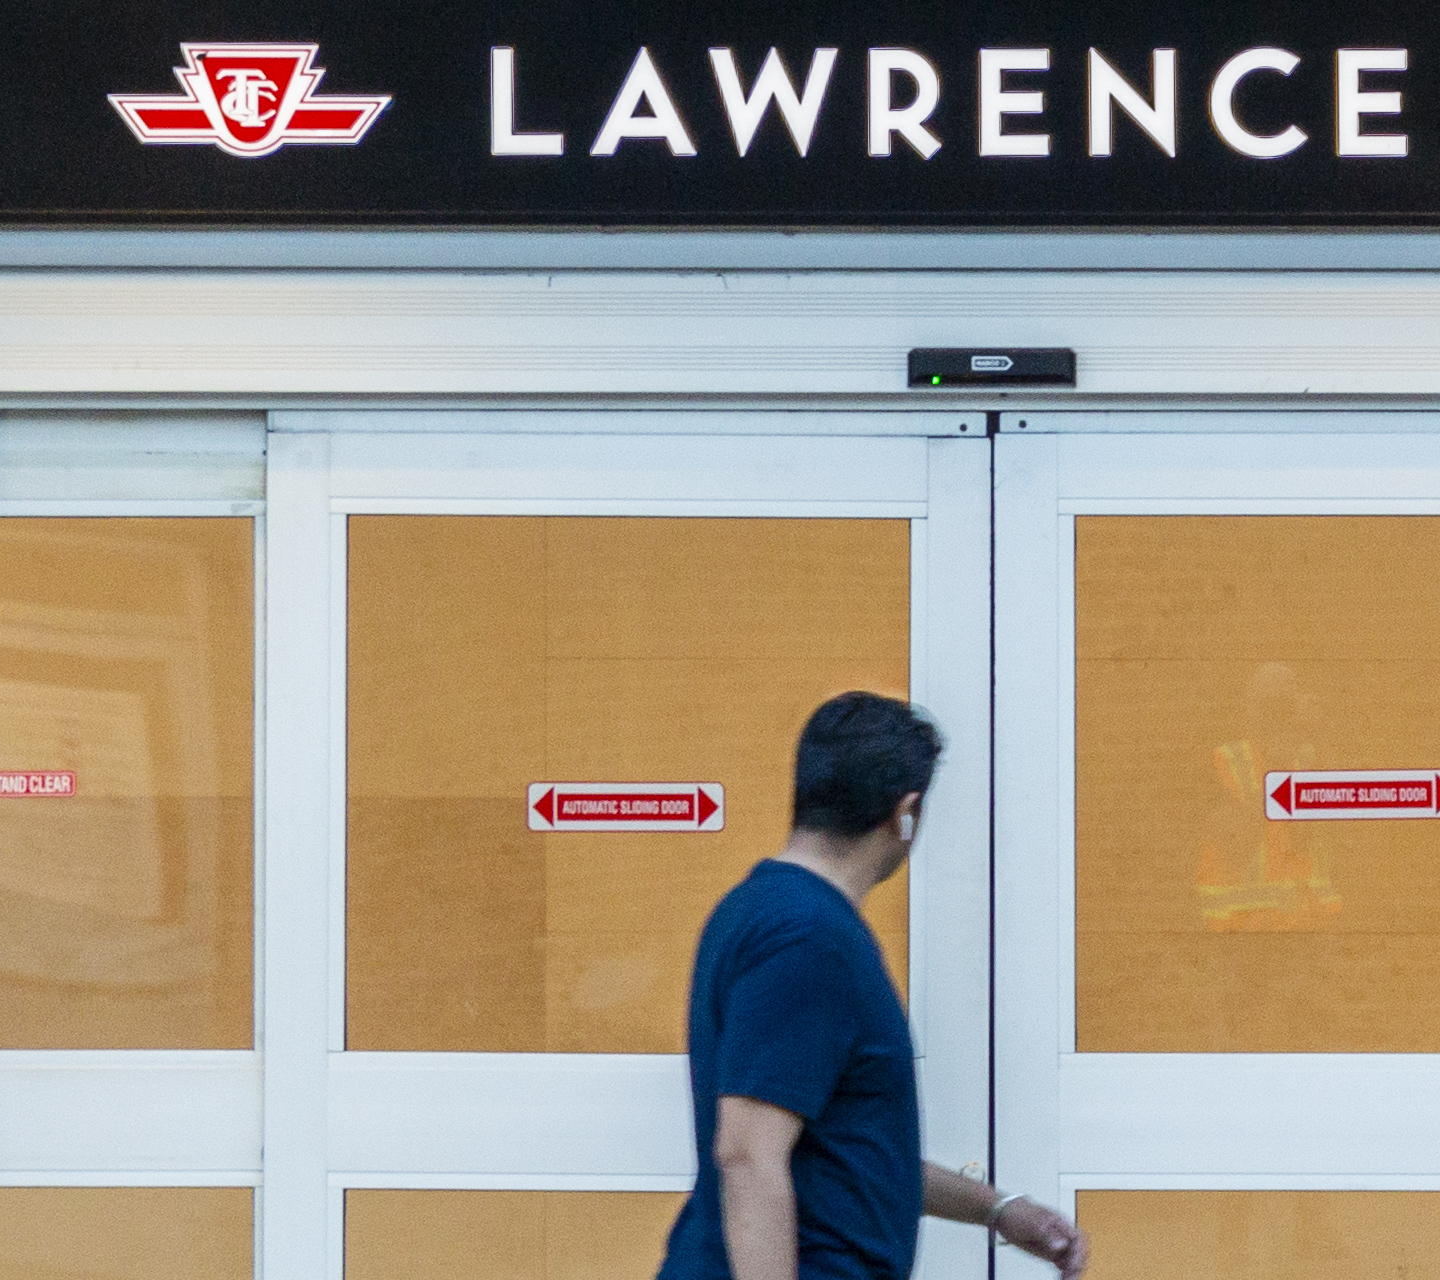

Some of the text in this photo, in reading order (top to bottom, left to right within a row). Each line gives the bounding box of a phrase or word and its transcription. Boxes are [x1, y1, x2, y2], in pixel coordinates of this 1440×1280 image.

[490, 46, 1409, 160] LAWRENCE
[29, 775, 71, 793] CLEAR
[1299, 787, 1428, 803] AUTOMATIC SLIDING DOOR
[562, 800, 690, 815] AUTOMATIC SLIDING DOOR
